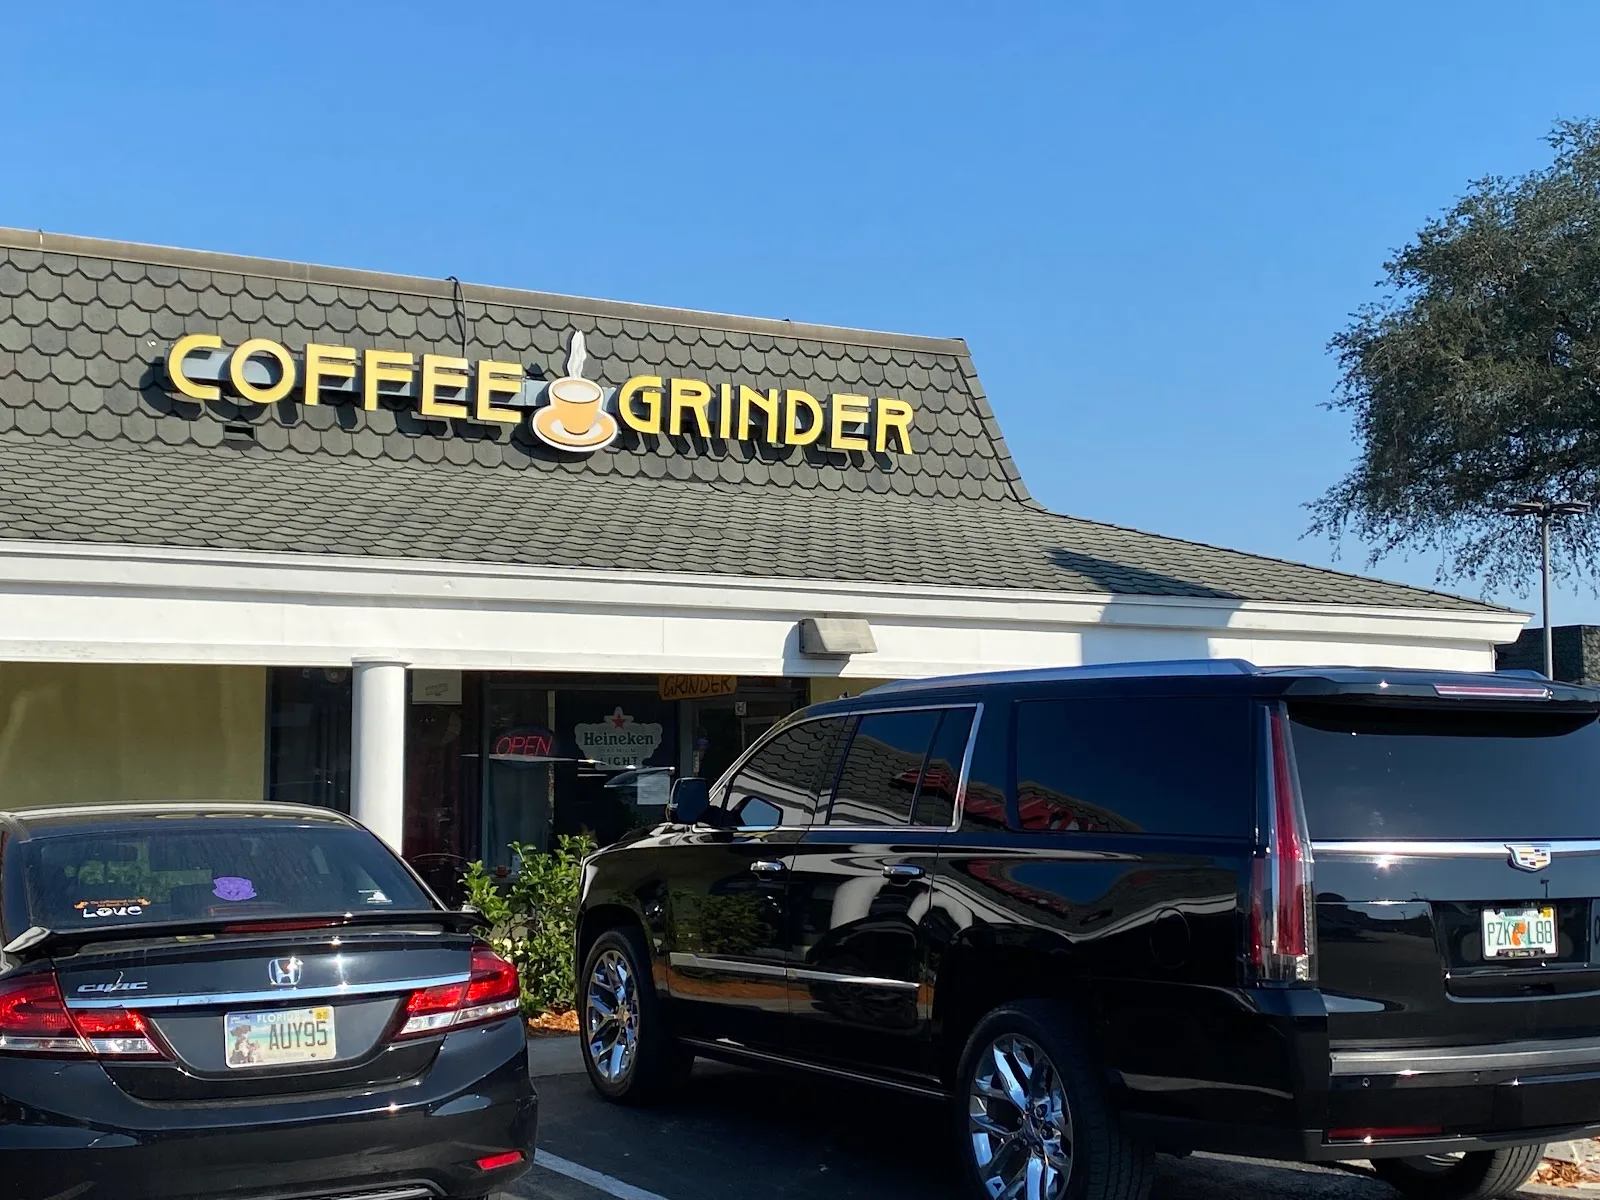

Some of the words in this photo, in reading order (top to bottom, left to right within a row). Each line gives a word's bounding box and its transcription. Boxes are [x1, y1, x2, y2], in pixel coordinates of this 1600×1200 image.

[167, 333, 524, 424] COFFEE
[617, 375, 914, 455] GRINDER
[663, 675, 731, 696] GRINDER
[496, 736, 553, 757] OPEN
[583, 732, 654, 746] Heineken
[600, 756, 638, 766] LIGHT
[1487, 921, 1512, 946] PZK
[1527, 920, 1553, 945] L88
[269, 1020, 328, 1050] AUY95
